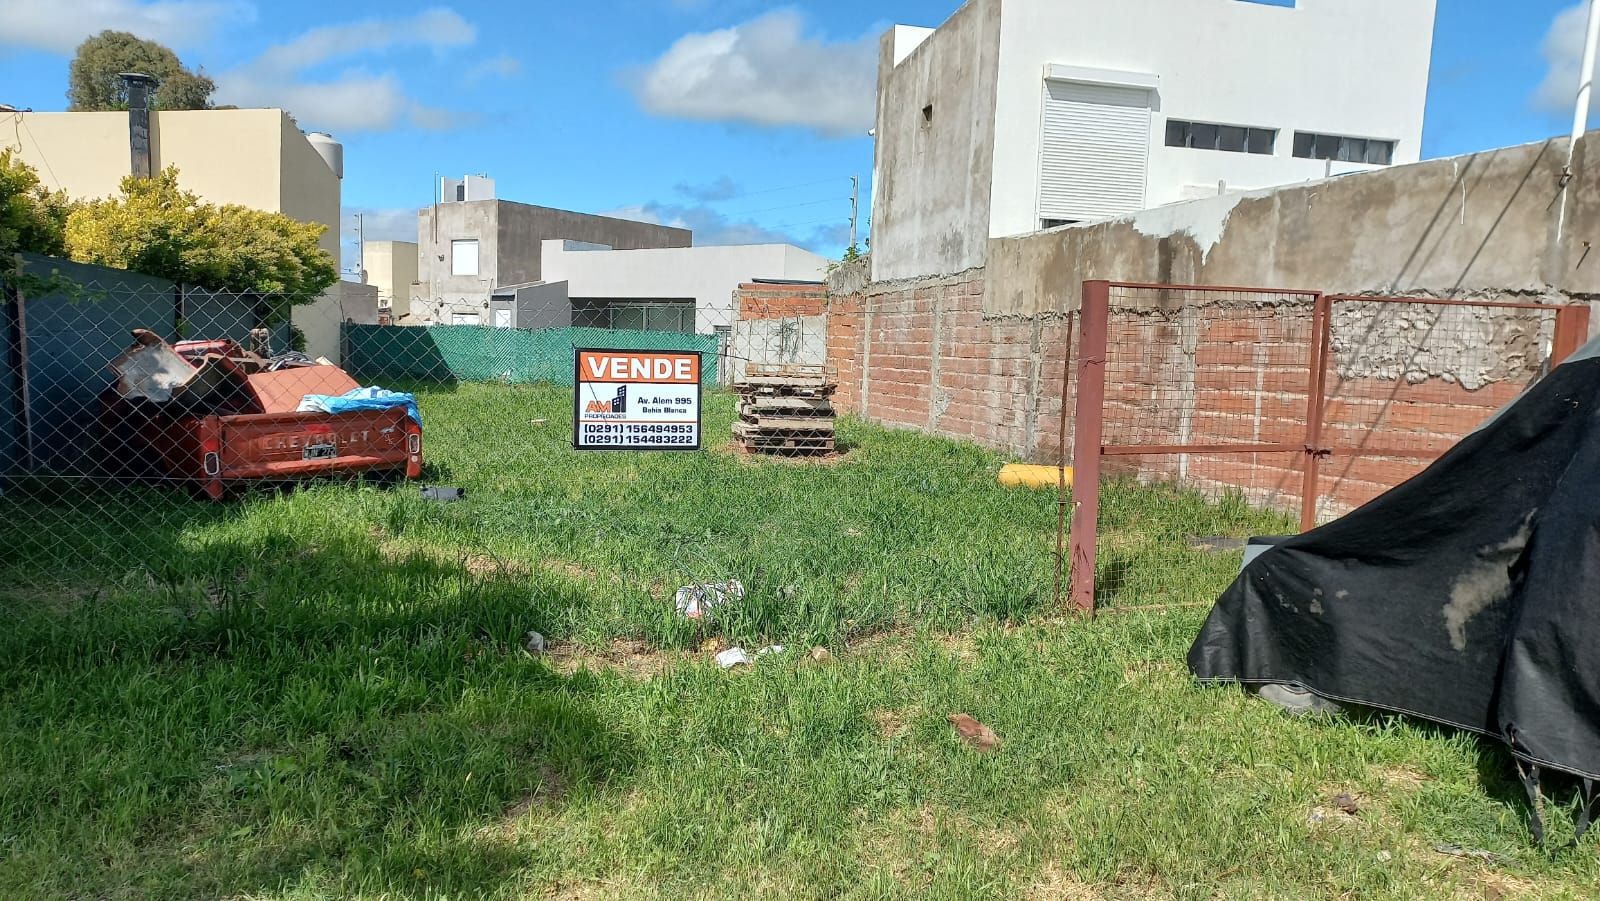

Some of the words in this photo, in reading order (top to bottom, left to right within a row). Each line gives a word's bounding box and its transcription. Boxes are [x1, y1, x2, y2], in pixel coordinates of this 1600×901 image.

[588, 356, 692, 379] VENDE
[585, 400, 611, 413] AM
[637, 397, 650, 405] Av.
[652, 397, 672, 405] Alem
